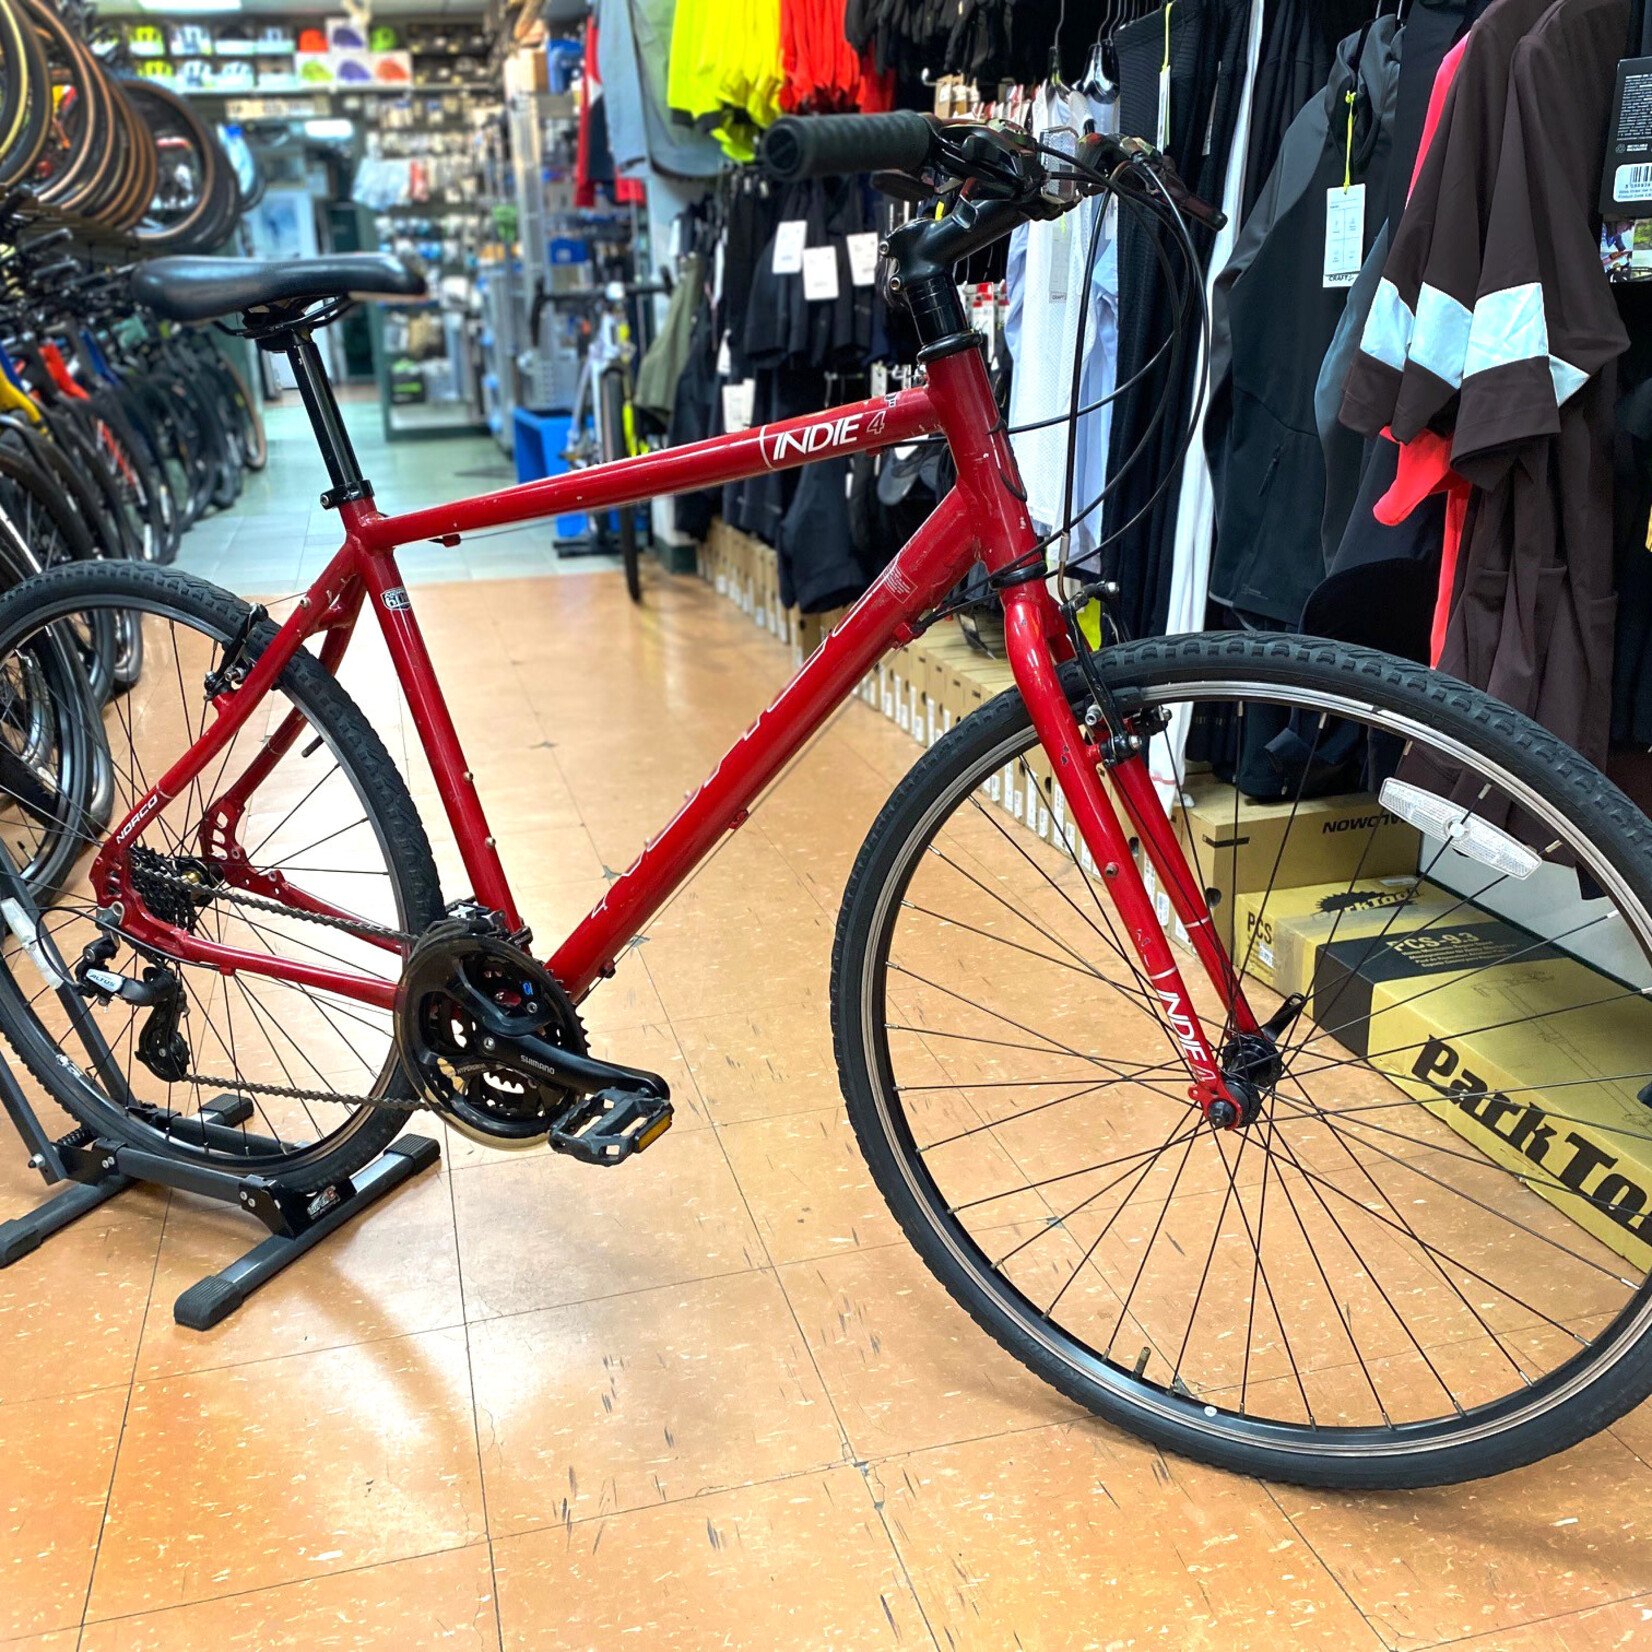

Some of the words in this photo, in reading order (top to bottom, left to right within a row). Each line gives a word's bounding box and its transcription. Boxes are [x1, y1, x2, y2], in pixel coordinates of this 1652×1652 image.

[772, 412, 864, 461] INDIE
[866, 410, 887, 436] 4
[116, 794, 158, 845] NORCO
[1247, 911, 1273, 945] PCS
[89, 974, 116, 987] ALTUS
[1156, 989, 1208, 1062] INDIE
[520, 1054, 555, 1075] SHIMANO
